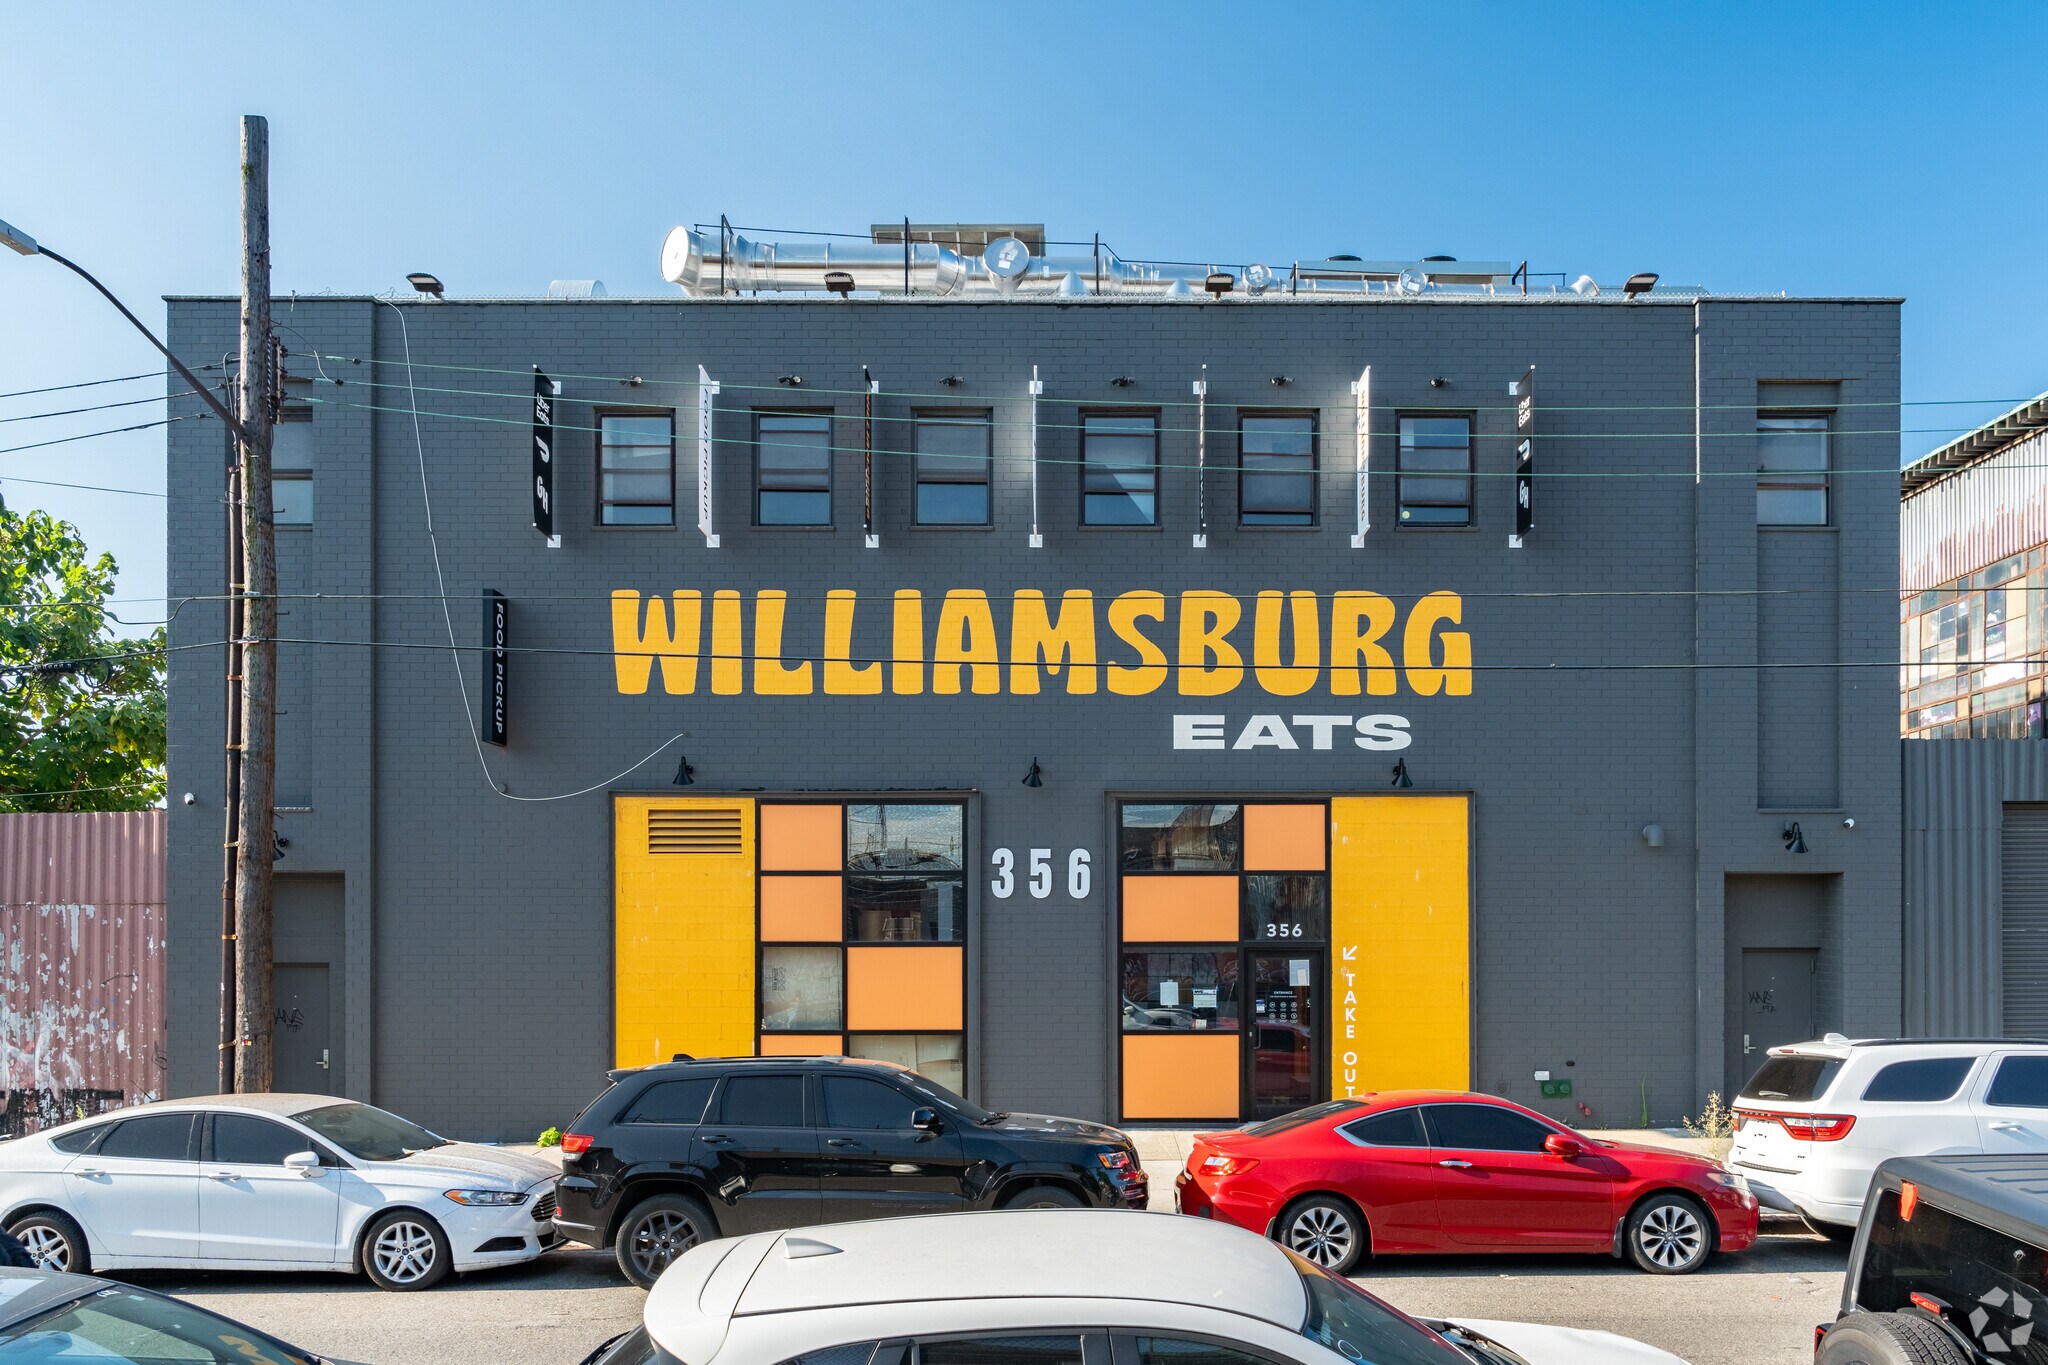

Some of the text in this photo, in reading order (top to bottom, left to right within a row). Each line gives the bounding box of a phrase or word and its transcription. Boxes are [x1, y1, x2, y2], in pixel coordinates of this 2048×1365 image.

[536, 393, 550, 410] Uber
[536, 407, 550, 426] Eats
[1518, 410, 1531, 428] Eats
[536, 476, 549, 514] GH
[1519, 480, 1529, 509] GH
[612, 588, 1473, 697] WILLIAMSBURG
[495, 603, 504, 734] FOOD PICKUP
[1173, 714, 1412, 752] EATS
[991, 847, 1091, 899] 356
[1266, 923, 1303, 938] 356
[1343, 973, 1358, 1098] TAKE OUT
